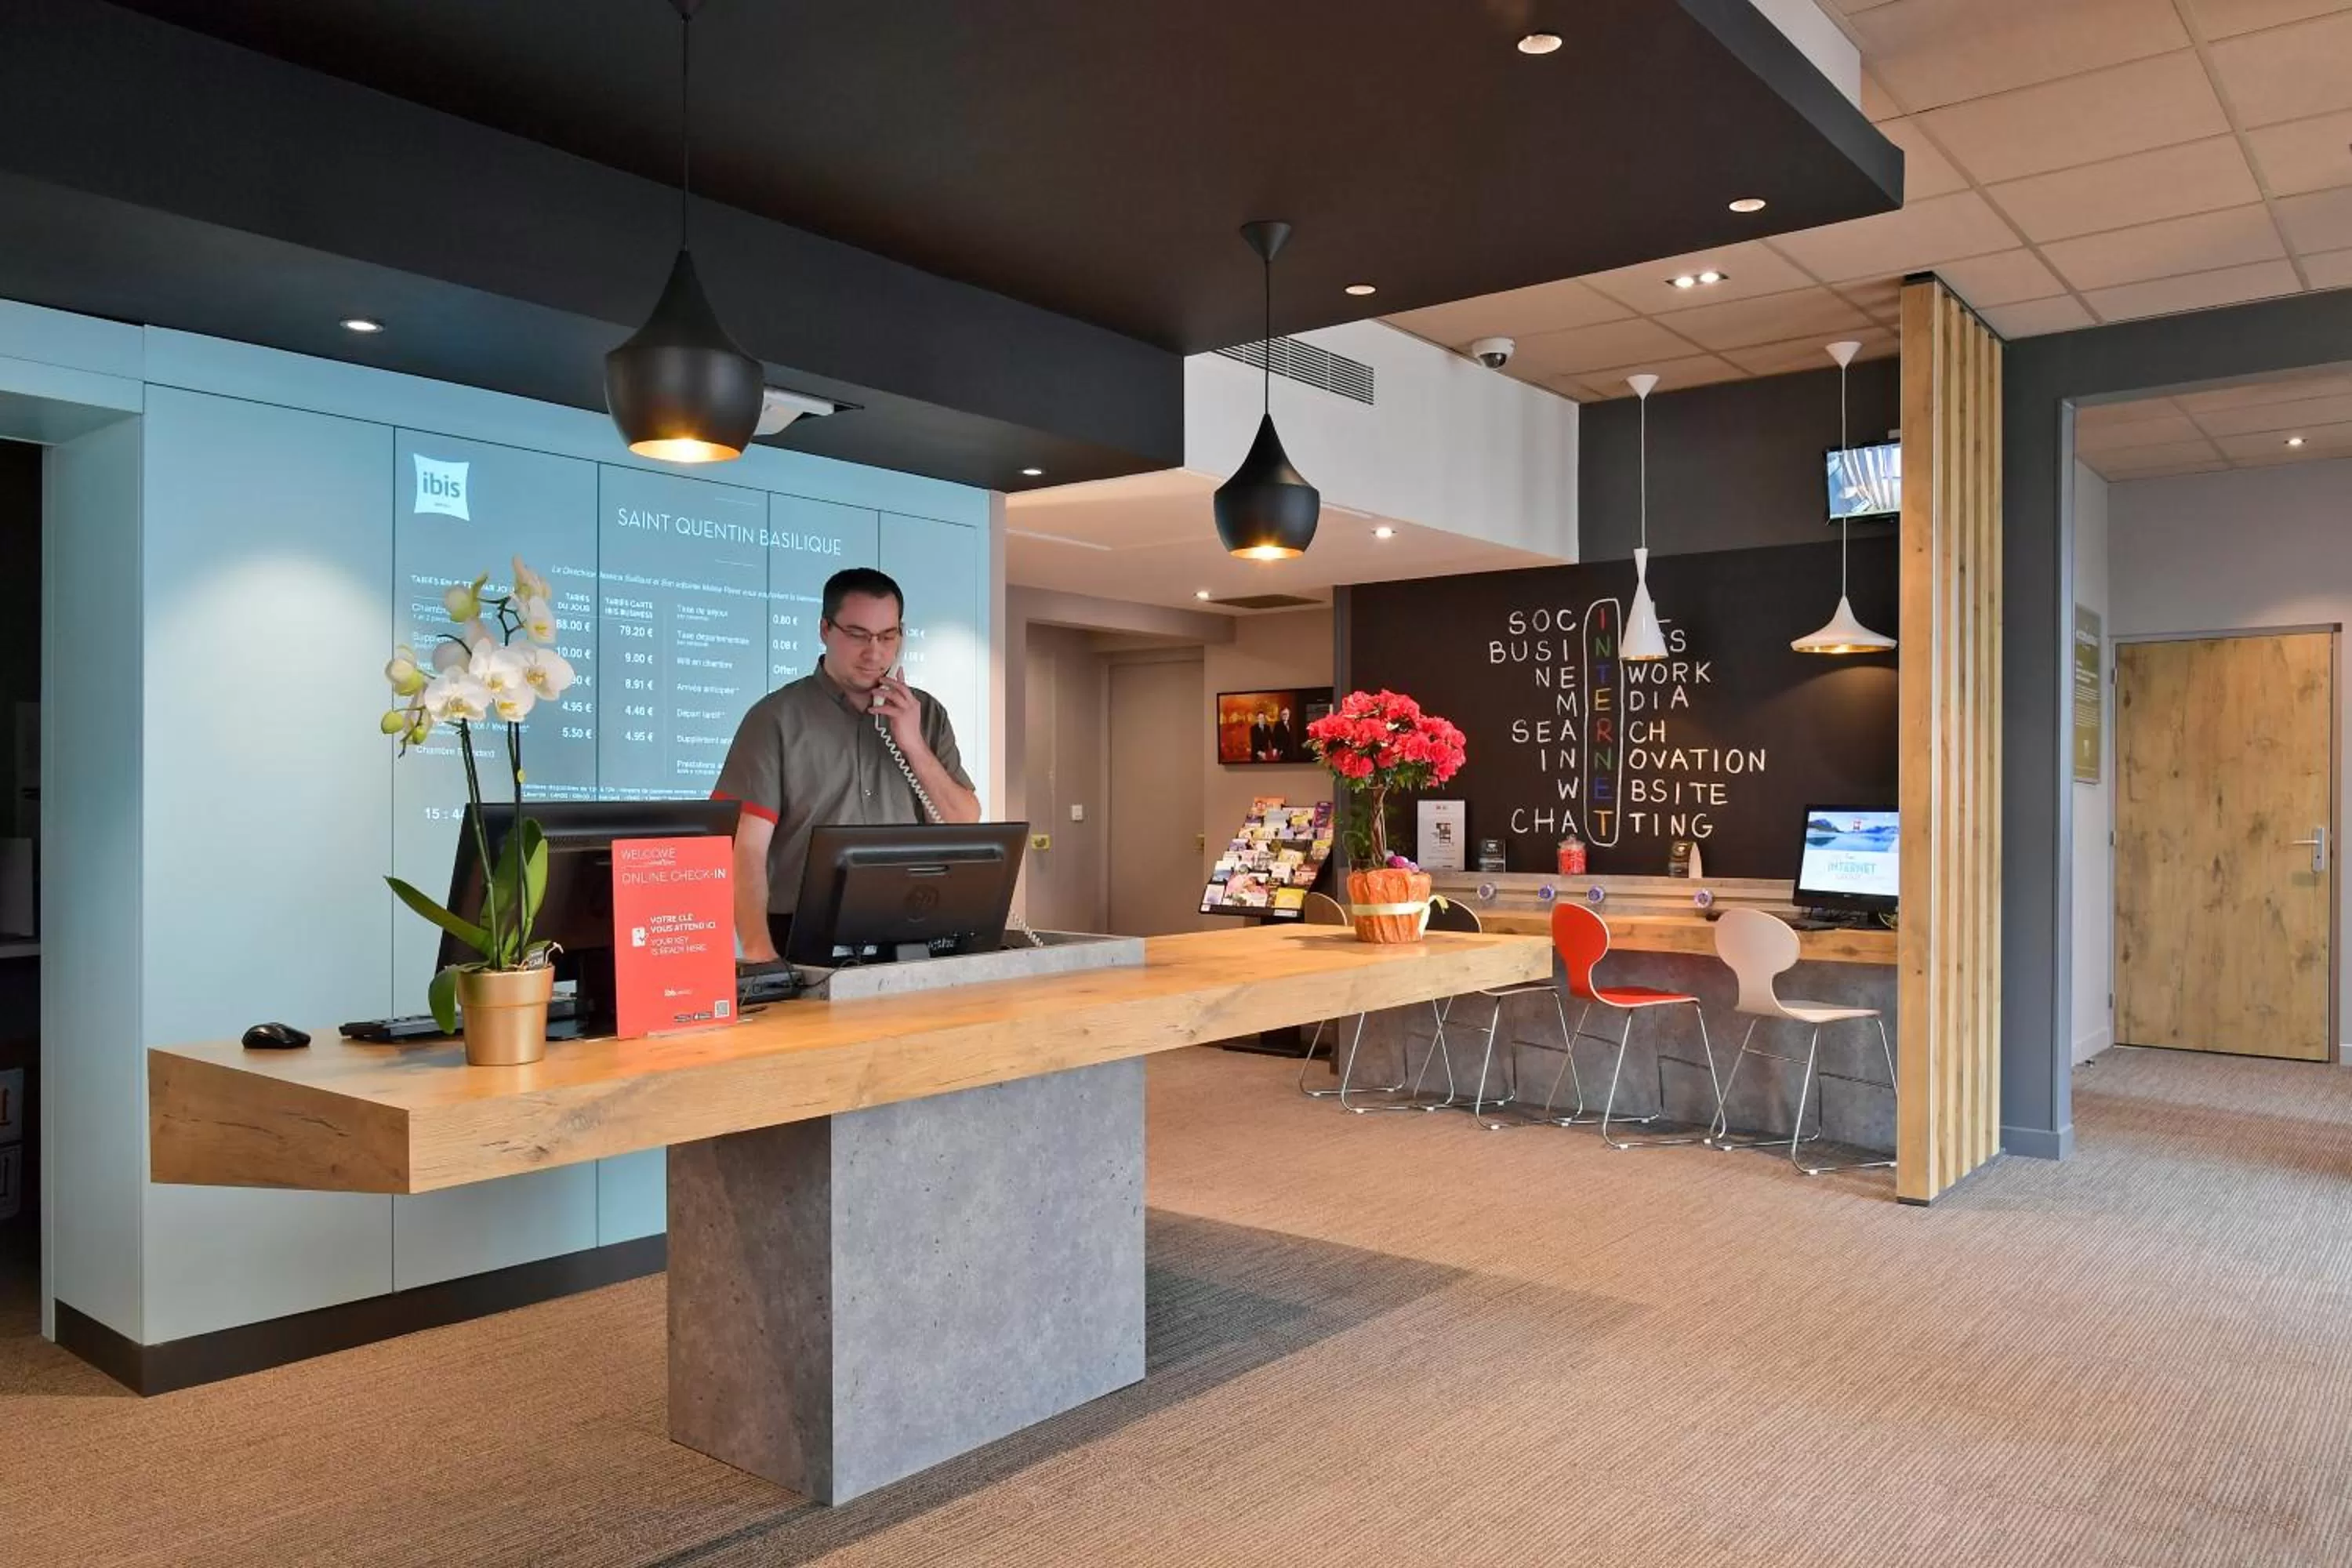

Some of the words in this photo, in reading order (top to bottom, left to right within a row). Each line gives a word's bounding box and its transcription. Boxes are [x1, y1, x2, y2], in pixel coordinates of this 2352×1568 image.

[423, 471, 461, 498] ibis
[617, 508, 671, 532] SAINT
[675, 517, 754, 544] QUENTIN
[759, 528, 842, 556] BASILIQUE
[647, 627, 653, 637] €
[425, 806, 440, 819] 15
[621, 848, 676, 860] WELCOME
[622, 870, 668, 884] ONLINE
[670, 868, 727, 881] CHECK-IN
[650, 915, 677, 924] VOTRE
[650, 924, 673, 934] VOUS
[673, 922, 704, 932] ATTEND
